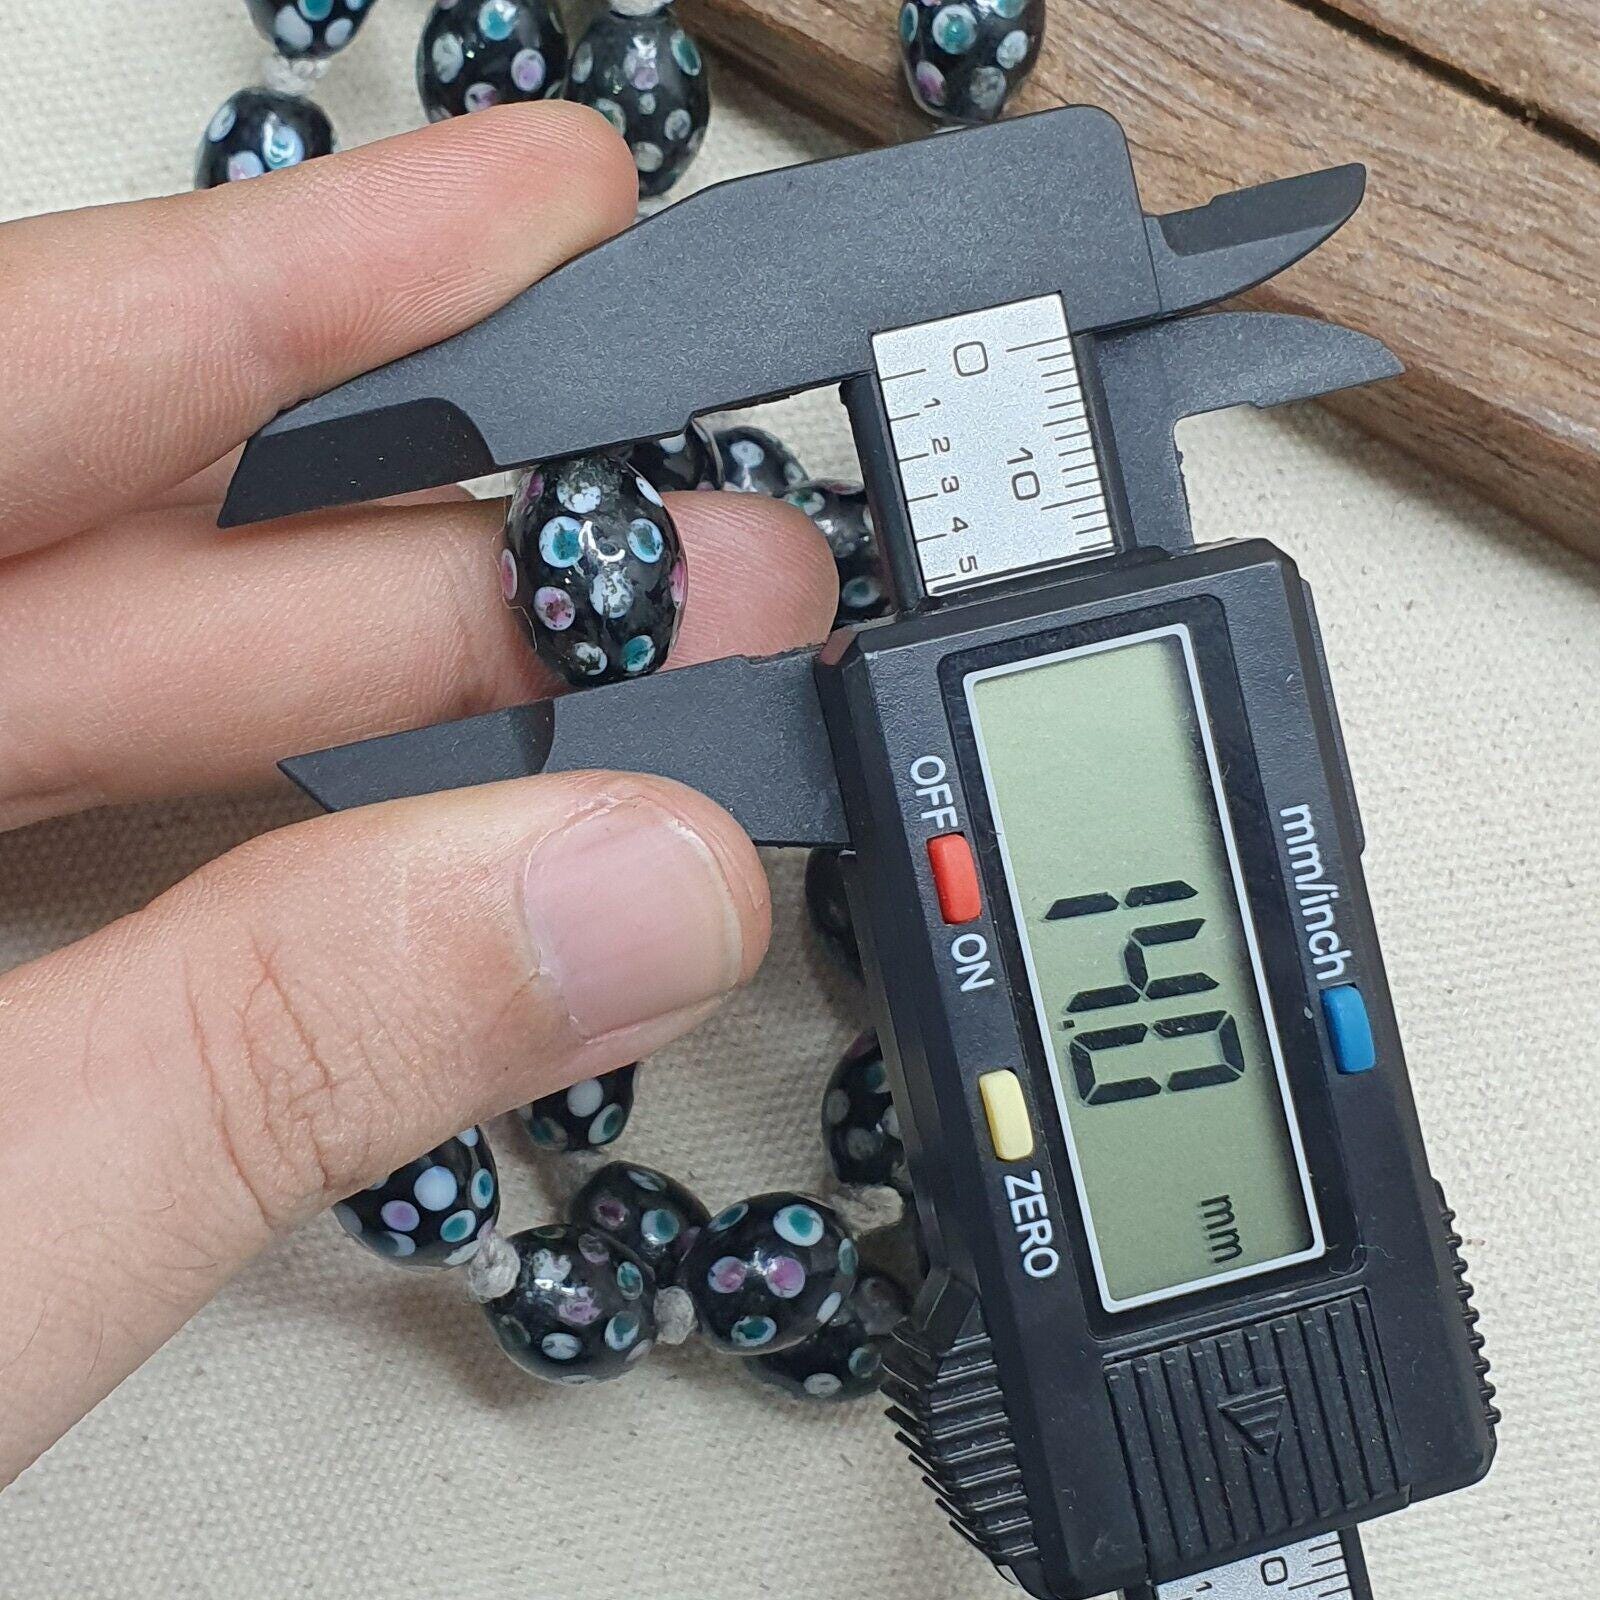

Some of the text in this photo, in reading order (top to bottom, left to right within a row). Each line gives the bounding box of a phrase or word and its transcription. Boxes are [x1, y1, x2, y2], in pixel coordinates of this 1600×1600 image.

[953, 341, 989, 377] 0
[924, 397, 941, 409] 1
[931, 436, 951, 455] 2
[941, 475, 960, 494] 3
[1006, 447, 1041, 501] 10
[951, 516, 969, 533] 4
[959, 555, 978, 574] 5
[909, 755, 958, 829] OFF
[1279, 803, 1352, 980] mm/inch
[951, 933, 995, 992] ON
[1044, 880, 1245, 1106] 14.0
[1004, 1169, 1060, 1278] ZERO
[1200, 1194, 1243, 1263] mm
[1195, 1580, 1212, 1592] 1
[1260, 1556, 1288, 1586] 0
